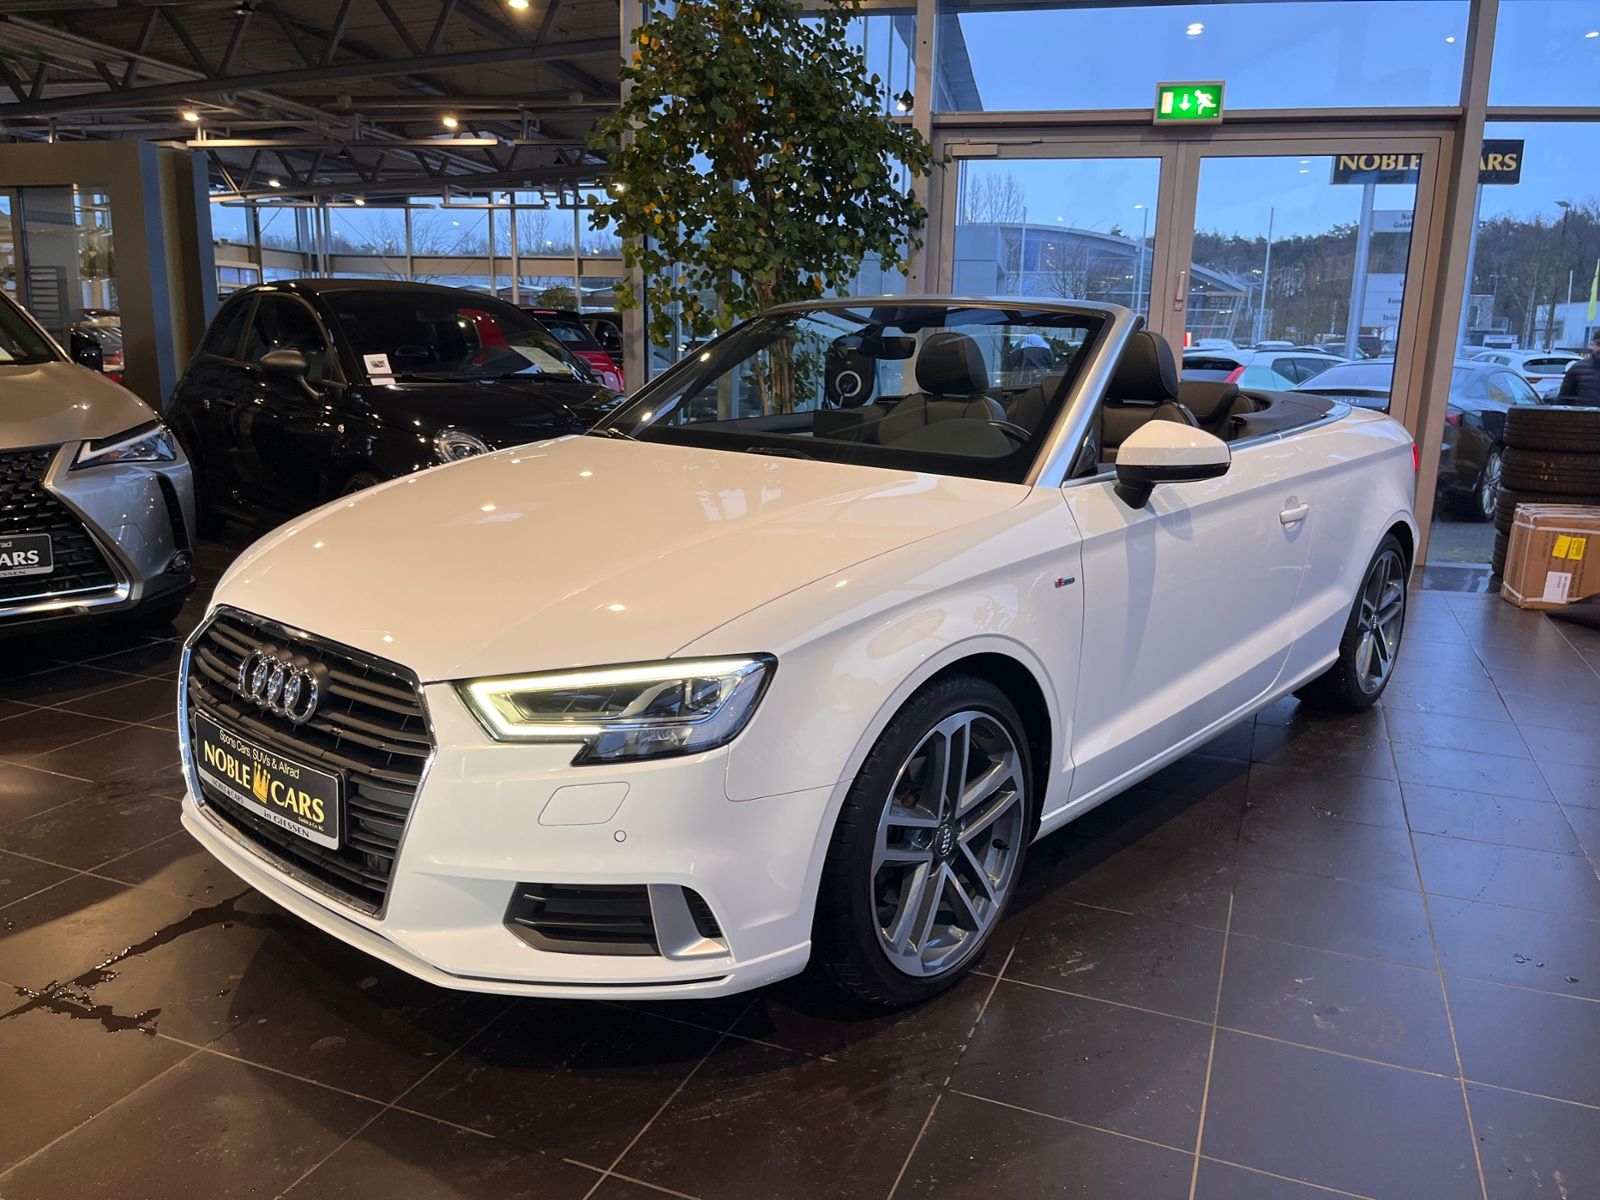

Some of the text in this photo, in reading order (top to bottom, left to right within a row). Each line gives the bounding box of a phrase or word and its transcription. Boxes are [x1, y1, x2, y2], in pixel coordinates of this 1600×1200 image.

[1339, 155, 1419, 171] NOBLE
[219, 729, 300, 779] Sports Cars, SUVs & Allrad
[204, 740, 325, 823] NOBLE CARS
[263, 810, 310, 838] in GIESSEN
